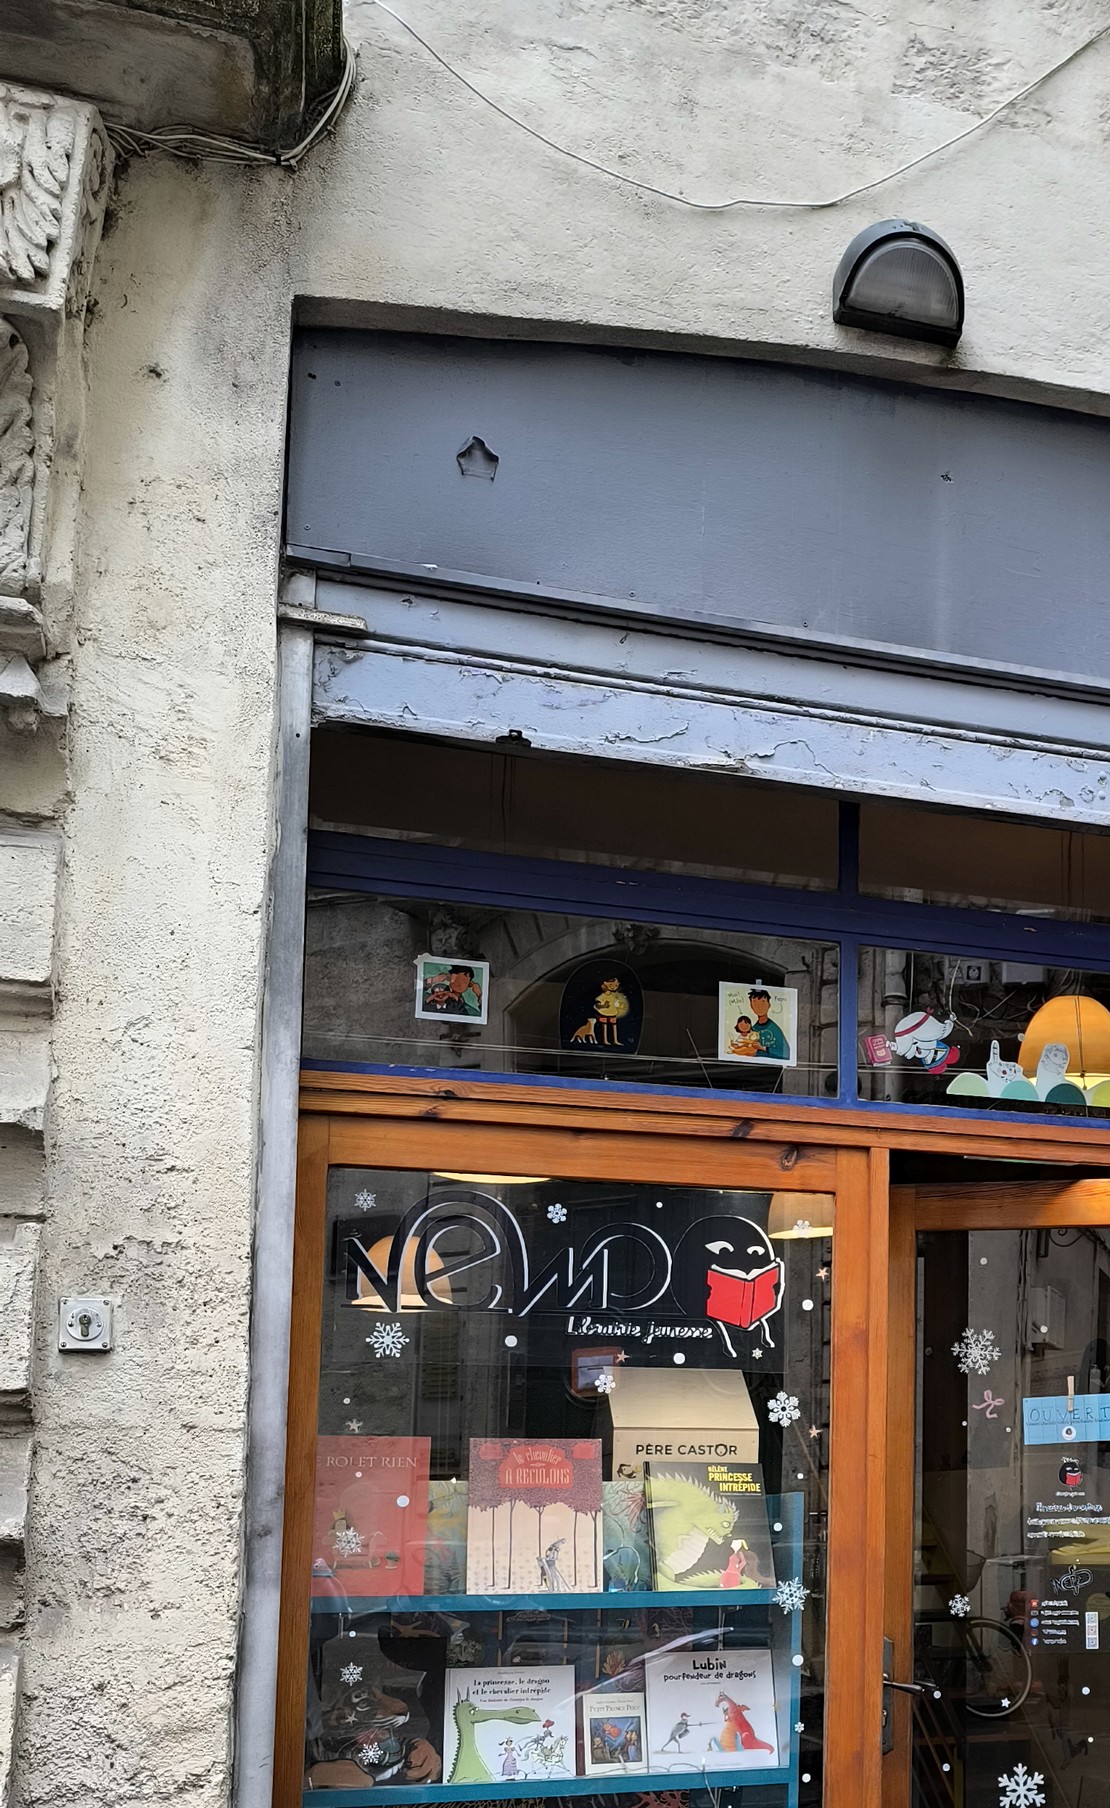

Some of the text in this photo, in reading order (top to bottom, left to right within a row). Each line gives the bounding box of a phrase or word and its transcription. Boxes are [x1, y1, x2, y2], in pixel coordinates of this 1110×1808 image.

[1029, 1406, 1110, 1422] OUVERT
[635, 1443, 738, 1457] PÈRE CASTOR
[326, 1456, 354, 1468] ROI
[359, 1456, 377, 1468] ET
[381, 1456, 417, 1468] RIEN
[516, 1467, 570, 1485] RECULONS
[708, 1472, 753, 1482] PRINCESSE
[719, 1481, 761, 1492] INTRÉPIDE
[663, 1670, 756, 1682] pourfendeur de dragons
